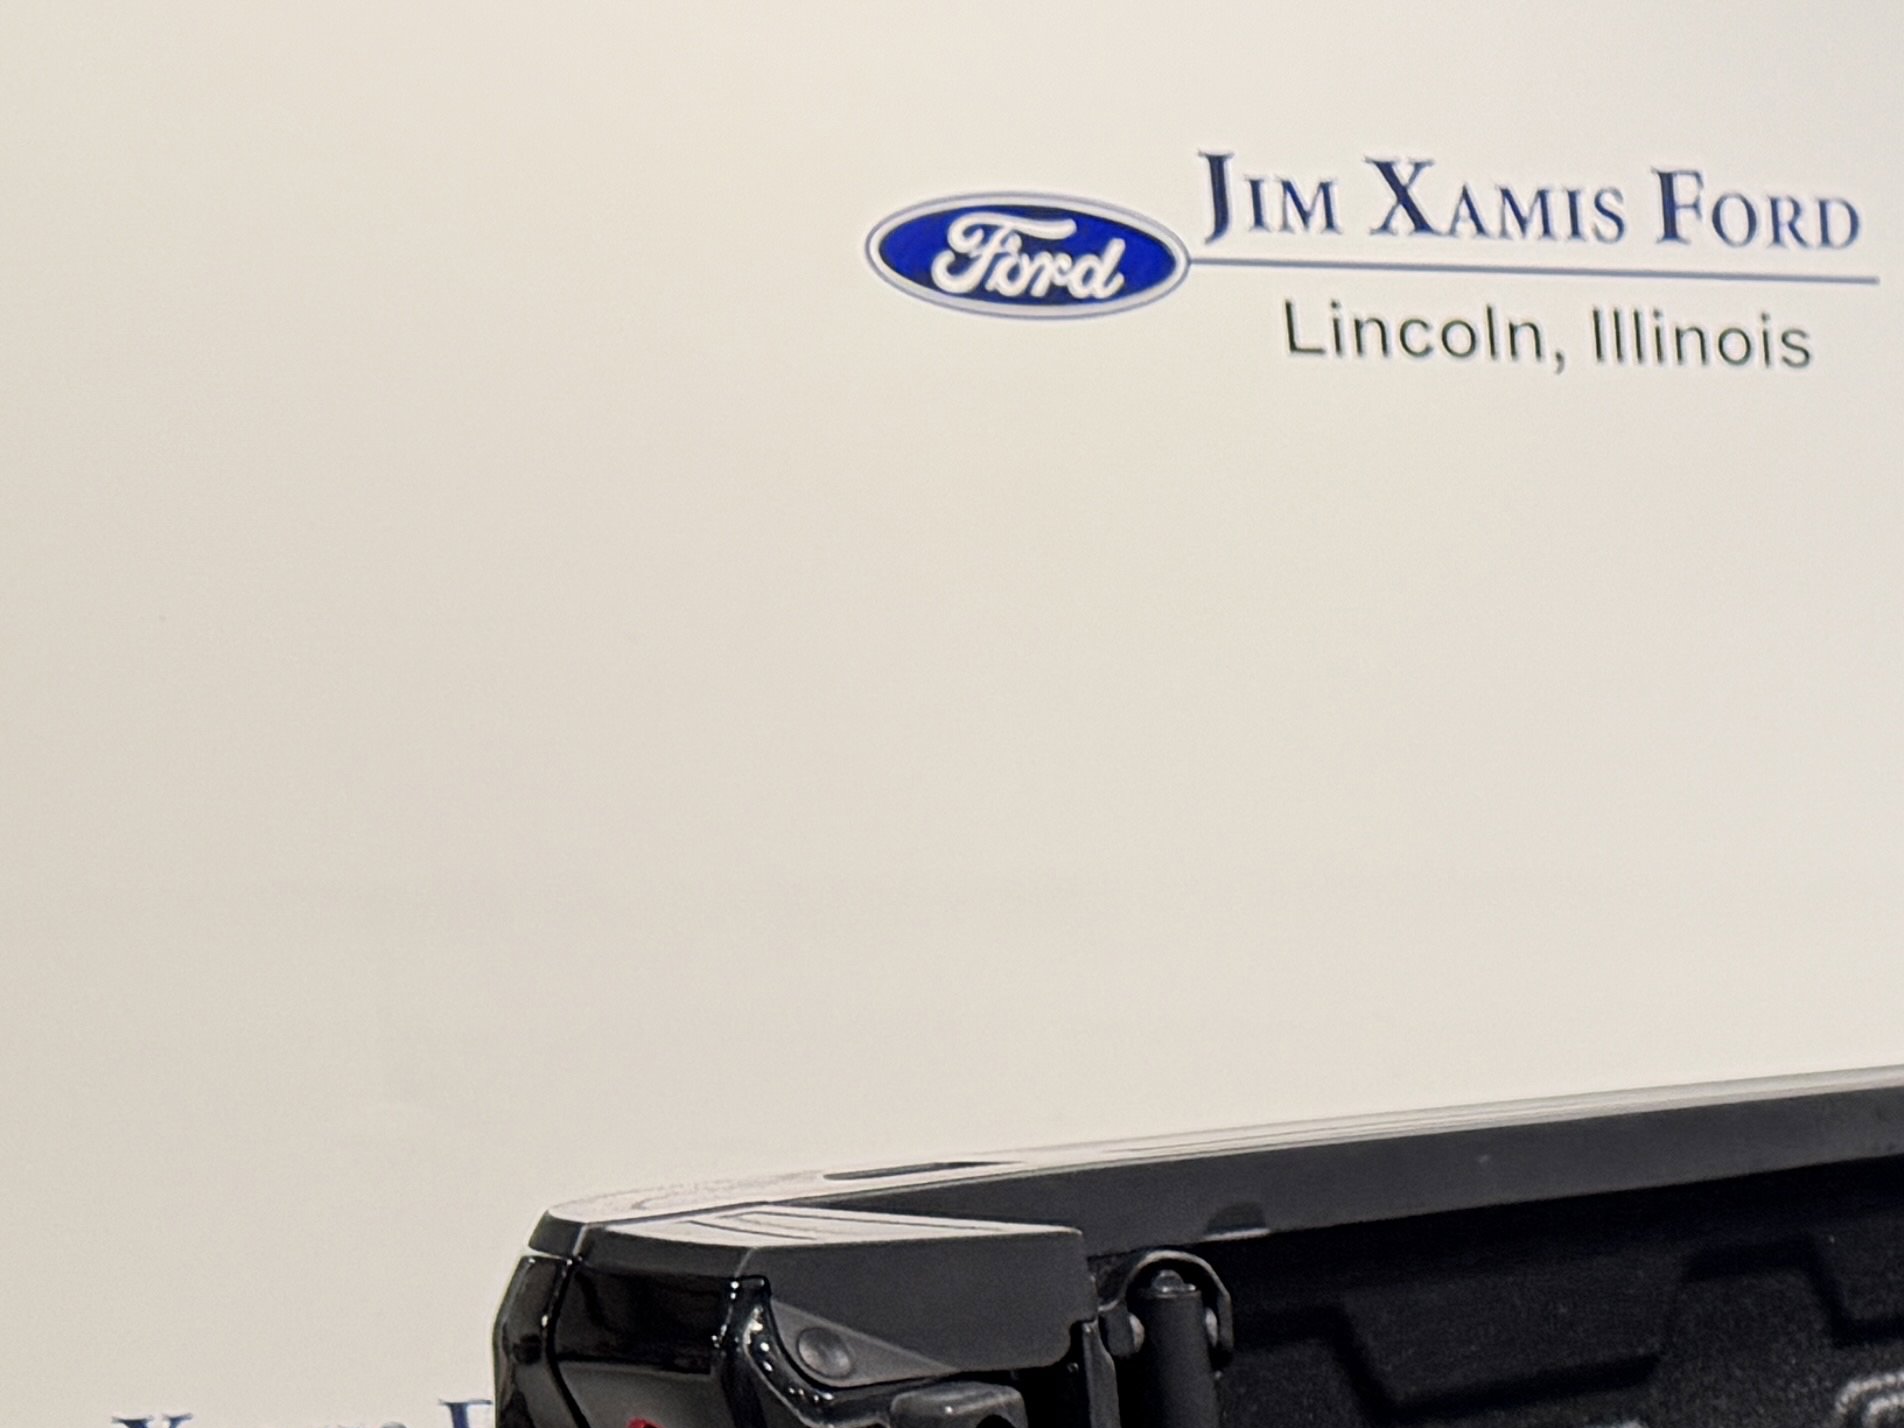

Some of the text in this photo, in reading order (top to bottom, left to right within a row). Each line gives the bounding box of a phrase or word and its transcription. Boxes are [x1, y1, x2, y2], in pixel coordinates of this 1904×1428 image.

[1197, 150, 1860, 249] JIM XAMIS FORD
[930, 211, 1126, 298] Ford
[1284, 298, 1811, 375] Lincoln, Illinois
